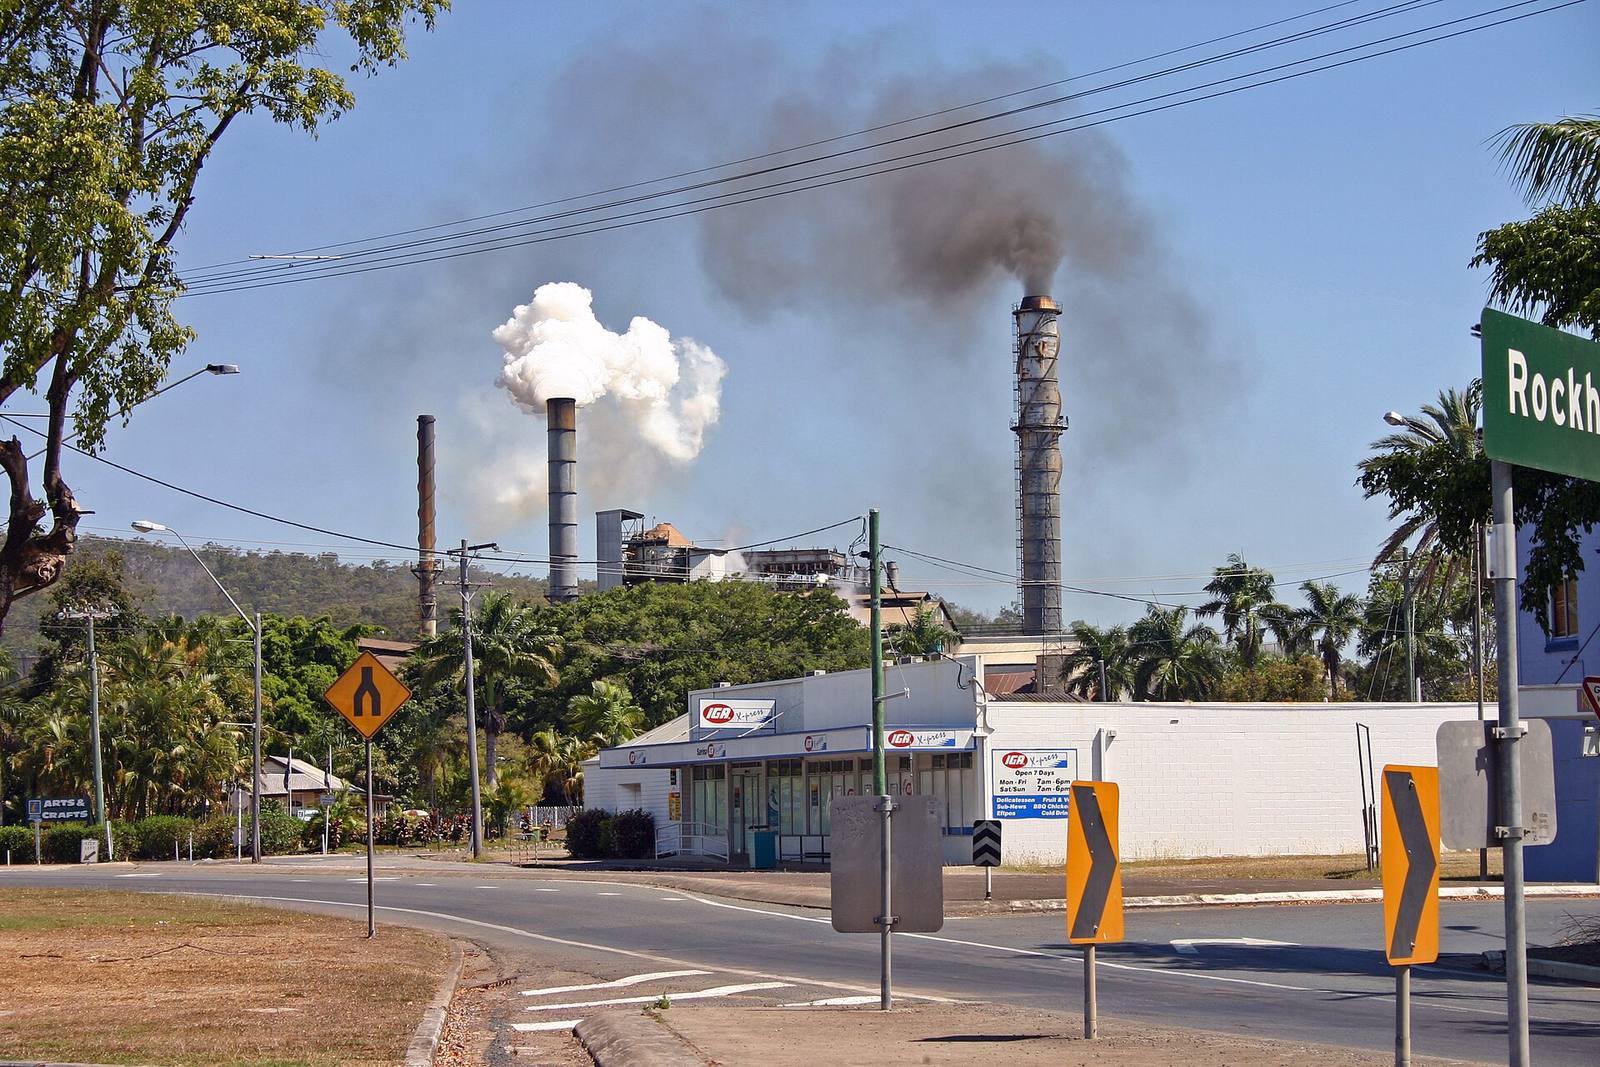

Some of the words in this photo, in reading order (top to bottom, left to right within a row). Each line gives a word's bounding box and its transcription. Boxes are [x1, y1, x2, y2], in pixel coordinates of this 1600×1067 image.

[706, 707, 731, 720] IGA
[736, 710, 764, 722] X-press
[891, 733, 911, 744] IGA
[917, 732, 947, 745] X-press
[1005, 755, 1025, 765] IGA
[1055, 778, 1071, 786] 6pm
[43, 799, 75, 808] ARTS
[76, 799, 85, 807] &
[42, 810, 88, 819] CRAFTS
